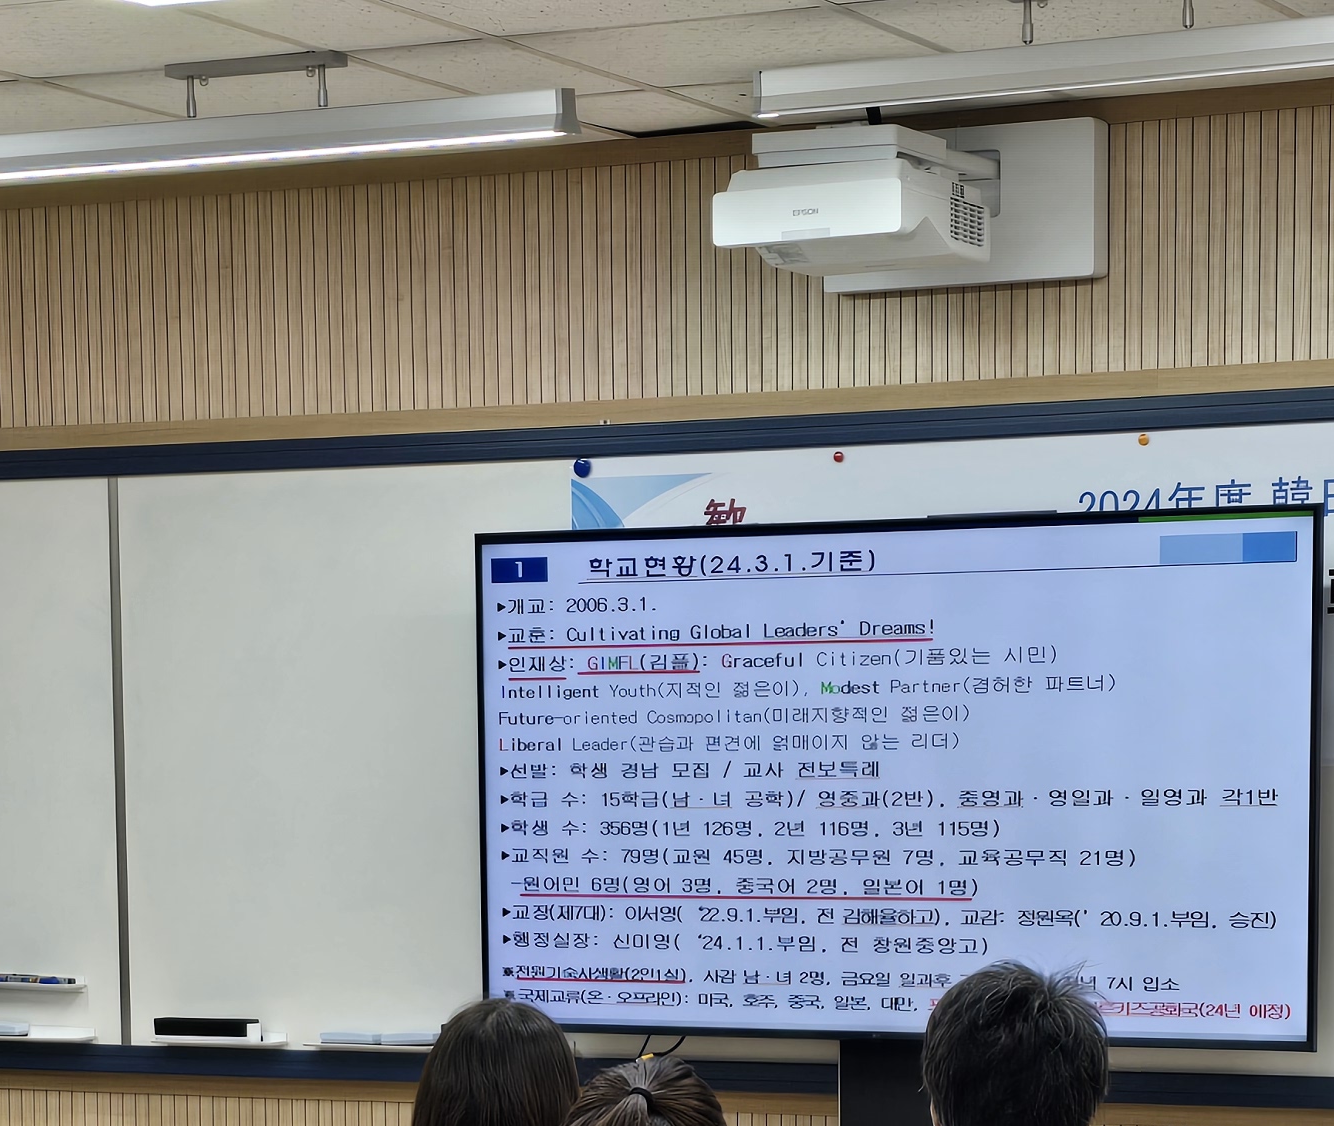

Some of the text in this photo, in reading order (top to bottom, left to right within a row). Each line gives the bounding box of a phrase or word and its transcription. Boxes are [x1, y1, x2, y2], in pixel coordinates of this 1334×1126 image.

[1078, 479, 1252, 514] 2024年度
[514, 561, 524, 579] 1
[588, 549, 876, 578] 학교현황(24.3.1.기준)
[566, 596, 657, 613] 2006.3.1.
[566, 625, 680, 642] Cultivating
[690, 623, 750, 640] Global
[859, 618, 934, 636] Dreams!
[721, 652, 803, 668] Graceful
[1003, 644, 1057, 664] 시민)
[501, 684, 599, 700] Intelligent
[820, 680, 880, 695] Modest
[1045, 673, 1117, 693] 파트너)
[498, 710, 638, 726] Future-oriented
[499, 737, 562, 752] Liberal
[705, 734, 761, 752] 편견에
[911, 731, 960, 750] 리더)
[570, 762, 608, 779] 학생
[621, 762, 659, 779] 경남
[671, 762, 710, 779] 모집
[743, 761, 784, 779] 교사
[510, 791, 549, 808] 학급
[713, 791, 731, 808] 녀
[1222, 788, 1279, 807] 각1반
[511, 819, 549, 837] 학생
[599, 819, 691, 838] 356명(1년
[774, 820, 805, 837] 2년
[892, 820, 923, 838] 3년
[938, 819, 1000, 838] 115명)
[512, 848, 569, 864] 교직원
[620, 847, 711, 865] 79명(교원
[787, 849, 891, 866] 지방공무원
[958, 849, 1067, 867] 교육공무직
[1079, 849, 1136, 868] 21명)
[736, 877, 796, 895] 중국어
[862, 878, 924, 896] 일본어
[938, 878, 978, 897] 1명)
[817, 907, 835, 925] 전
[1229, 911, 1277, 930] 승진)
[841, 936, 858, 953] 전
[703, 969, 737, 984] 사감
[841, 971, 891, 987] 금요일
[1107, 976, 1133, 992] 7시
[1142, 976, 1180, 992] 입소
